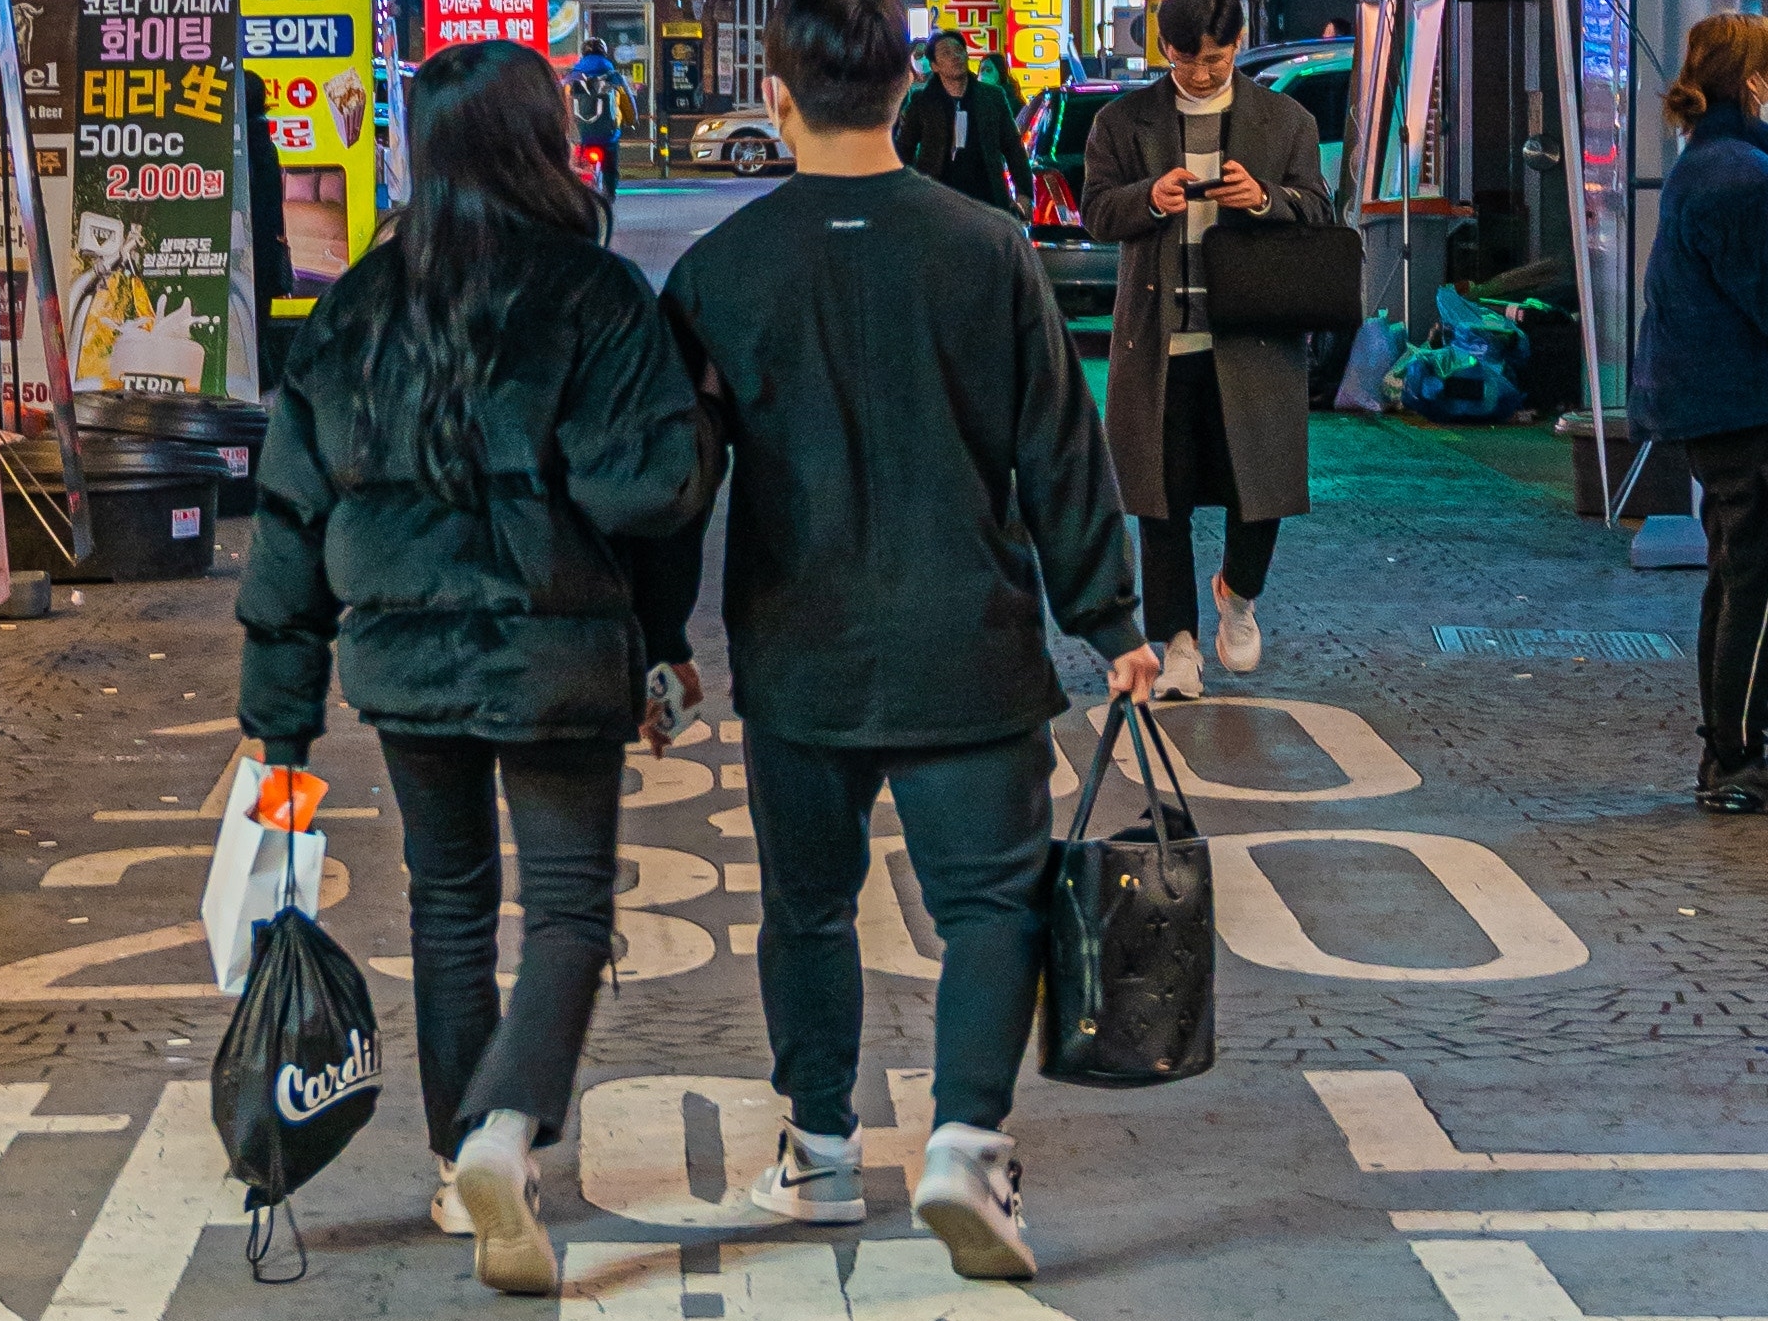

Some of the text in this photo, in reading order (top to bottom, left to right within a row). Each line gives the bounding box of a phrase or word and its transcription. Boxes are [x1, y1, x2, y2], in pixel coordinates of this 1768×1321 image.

[100, 16, 212, 62] 화이팅
[439, 17, 534, 42] 세계주류 할인
[83, 69, 171, 119] 테라
[175, 64, 228, 124] 生
[79, 123, 184, 158] 500cc
[106, 163, 225, 202] 2,000원
